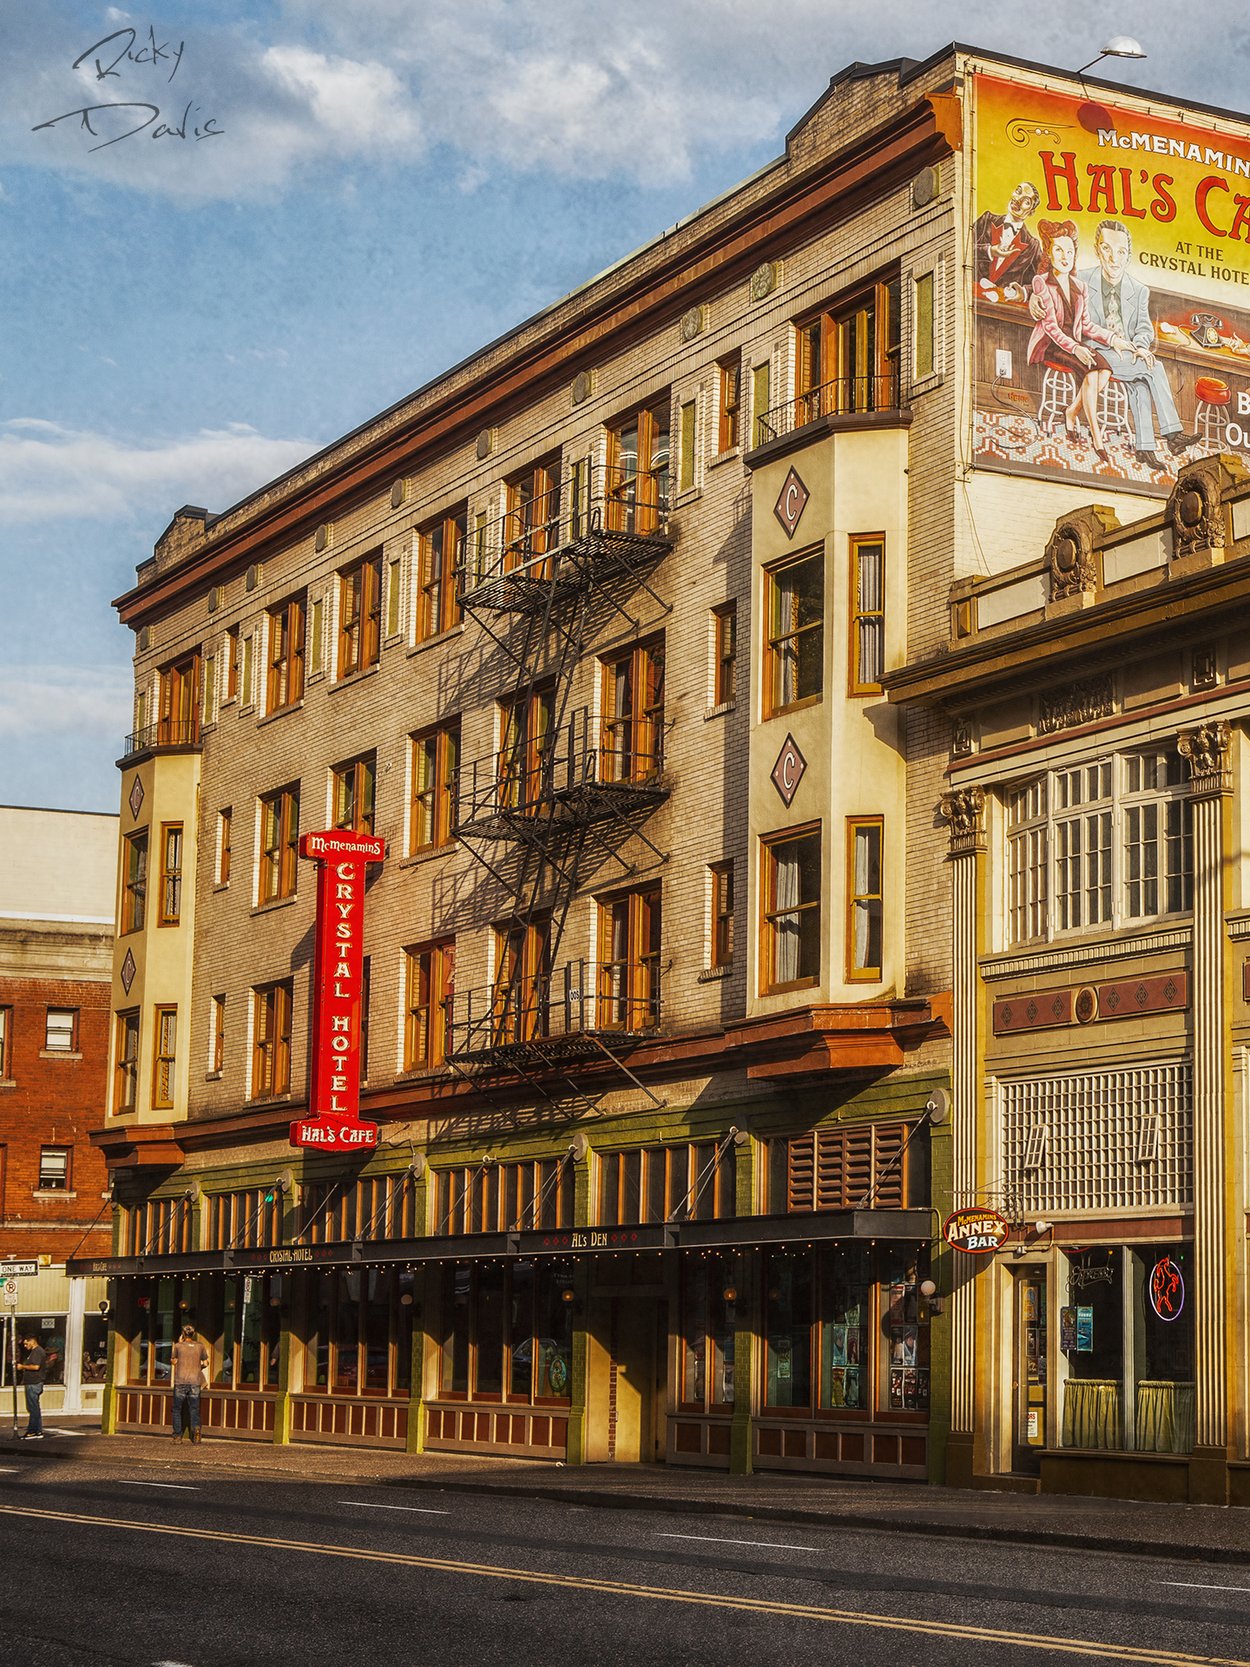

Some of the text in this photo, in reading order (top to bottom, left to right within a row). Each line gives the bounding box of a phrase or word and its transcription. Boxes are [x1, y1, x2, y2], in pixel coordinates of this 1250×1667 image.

[1038, 150, 1178, 223] HAL'S
[1175, 241, 1224, 262] AT THE
[1139, 251, 1207, 276] CRYSTAL
[333, 862, 356, 998] CRYSTAL
[331, 1015, 350, 1111] HOTEL
[339, 1126, 374, 1143] CAFE
[590, 1231, 608, 1247] DEN
[947, 1220, 1006, 1242] ANNEX
[966, 1235, 999, 1250] BAR
[292, 1248, 313, 1261] HOTEL
[1, 1264, 33, 1273] ONE WAY
